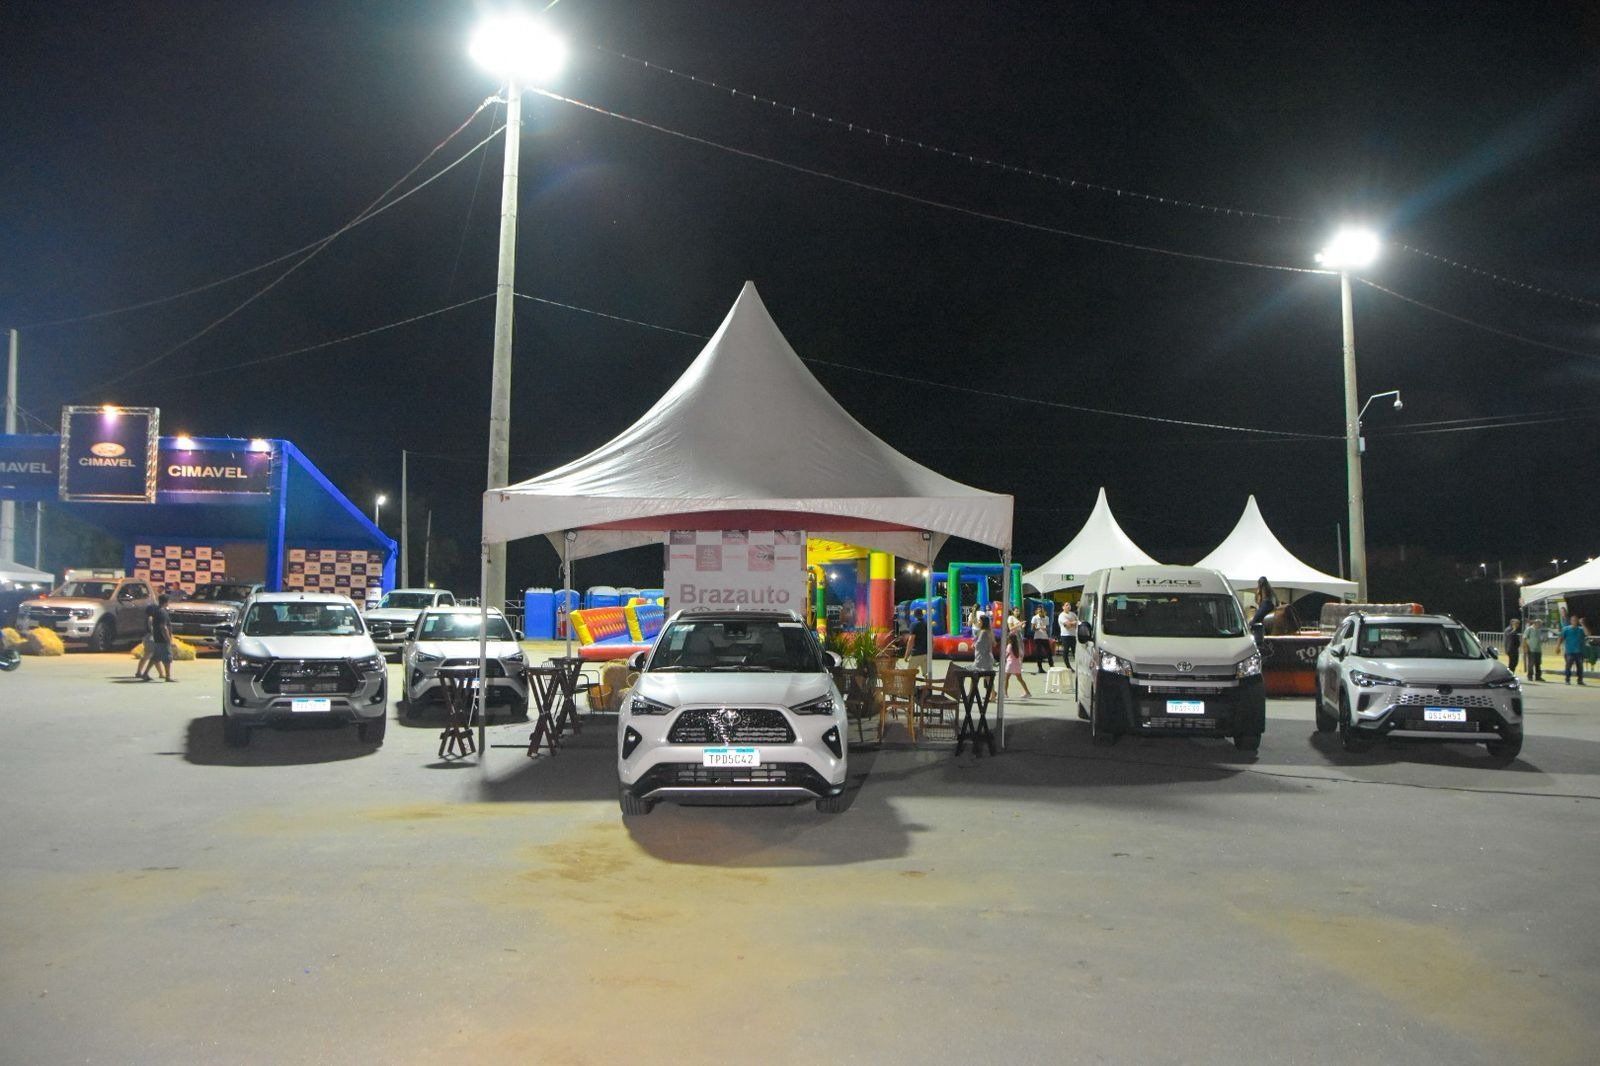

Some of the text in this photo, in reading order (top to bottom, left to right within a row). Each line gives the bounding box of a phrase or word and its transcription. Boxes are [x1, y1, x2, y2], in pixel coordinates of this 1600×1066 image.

[79, 457, 136, 468] CIMAVEL
[168, 465, 247, 479] CIMAVEL
[680, 583, 790, 604] Brazauto
[709, 754, 754, 764] TPD5C42
